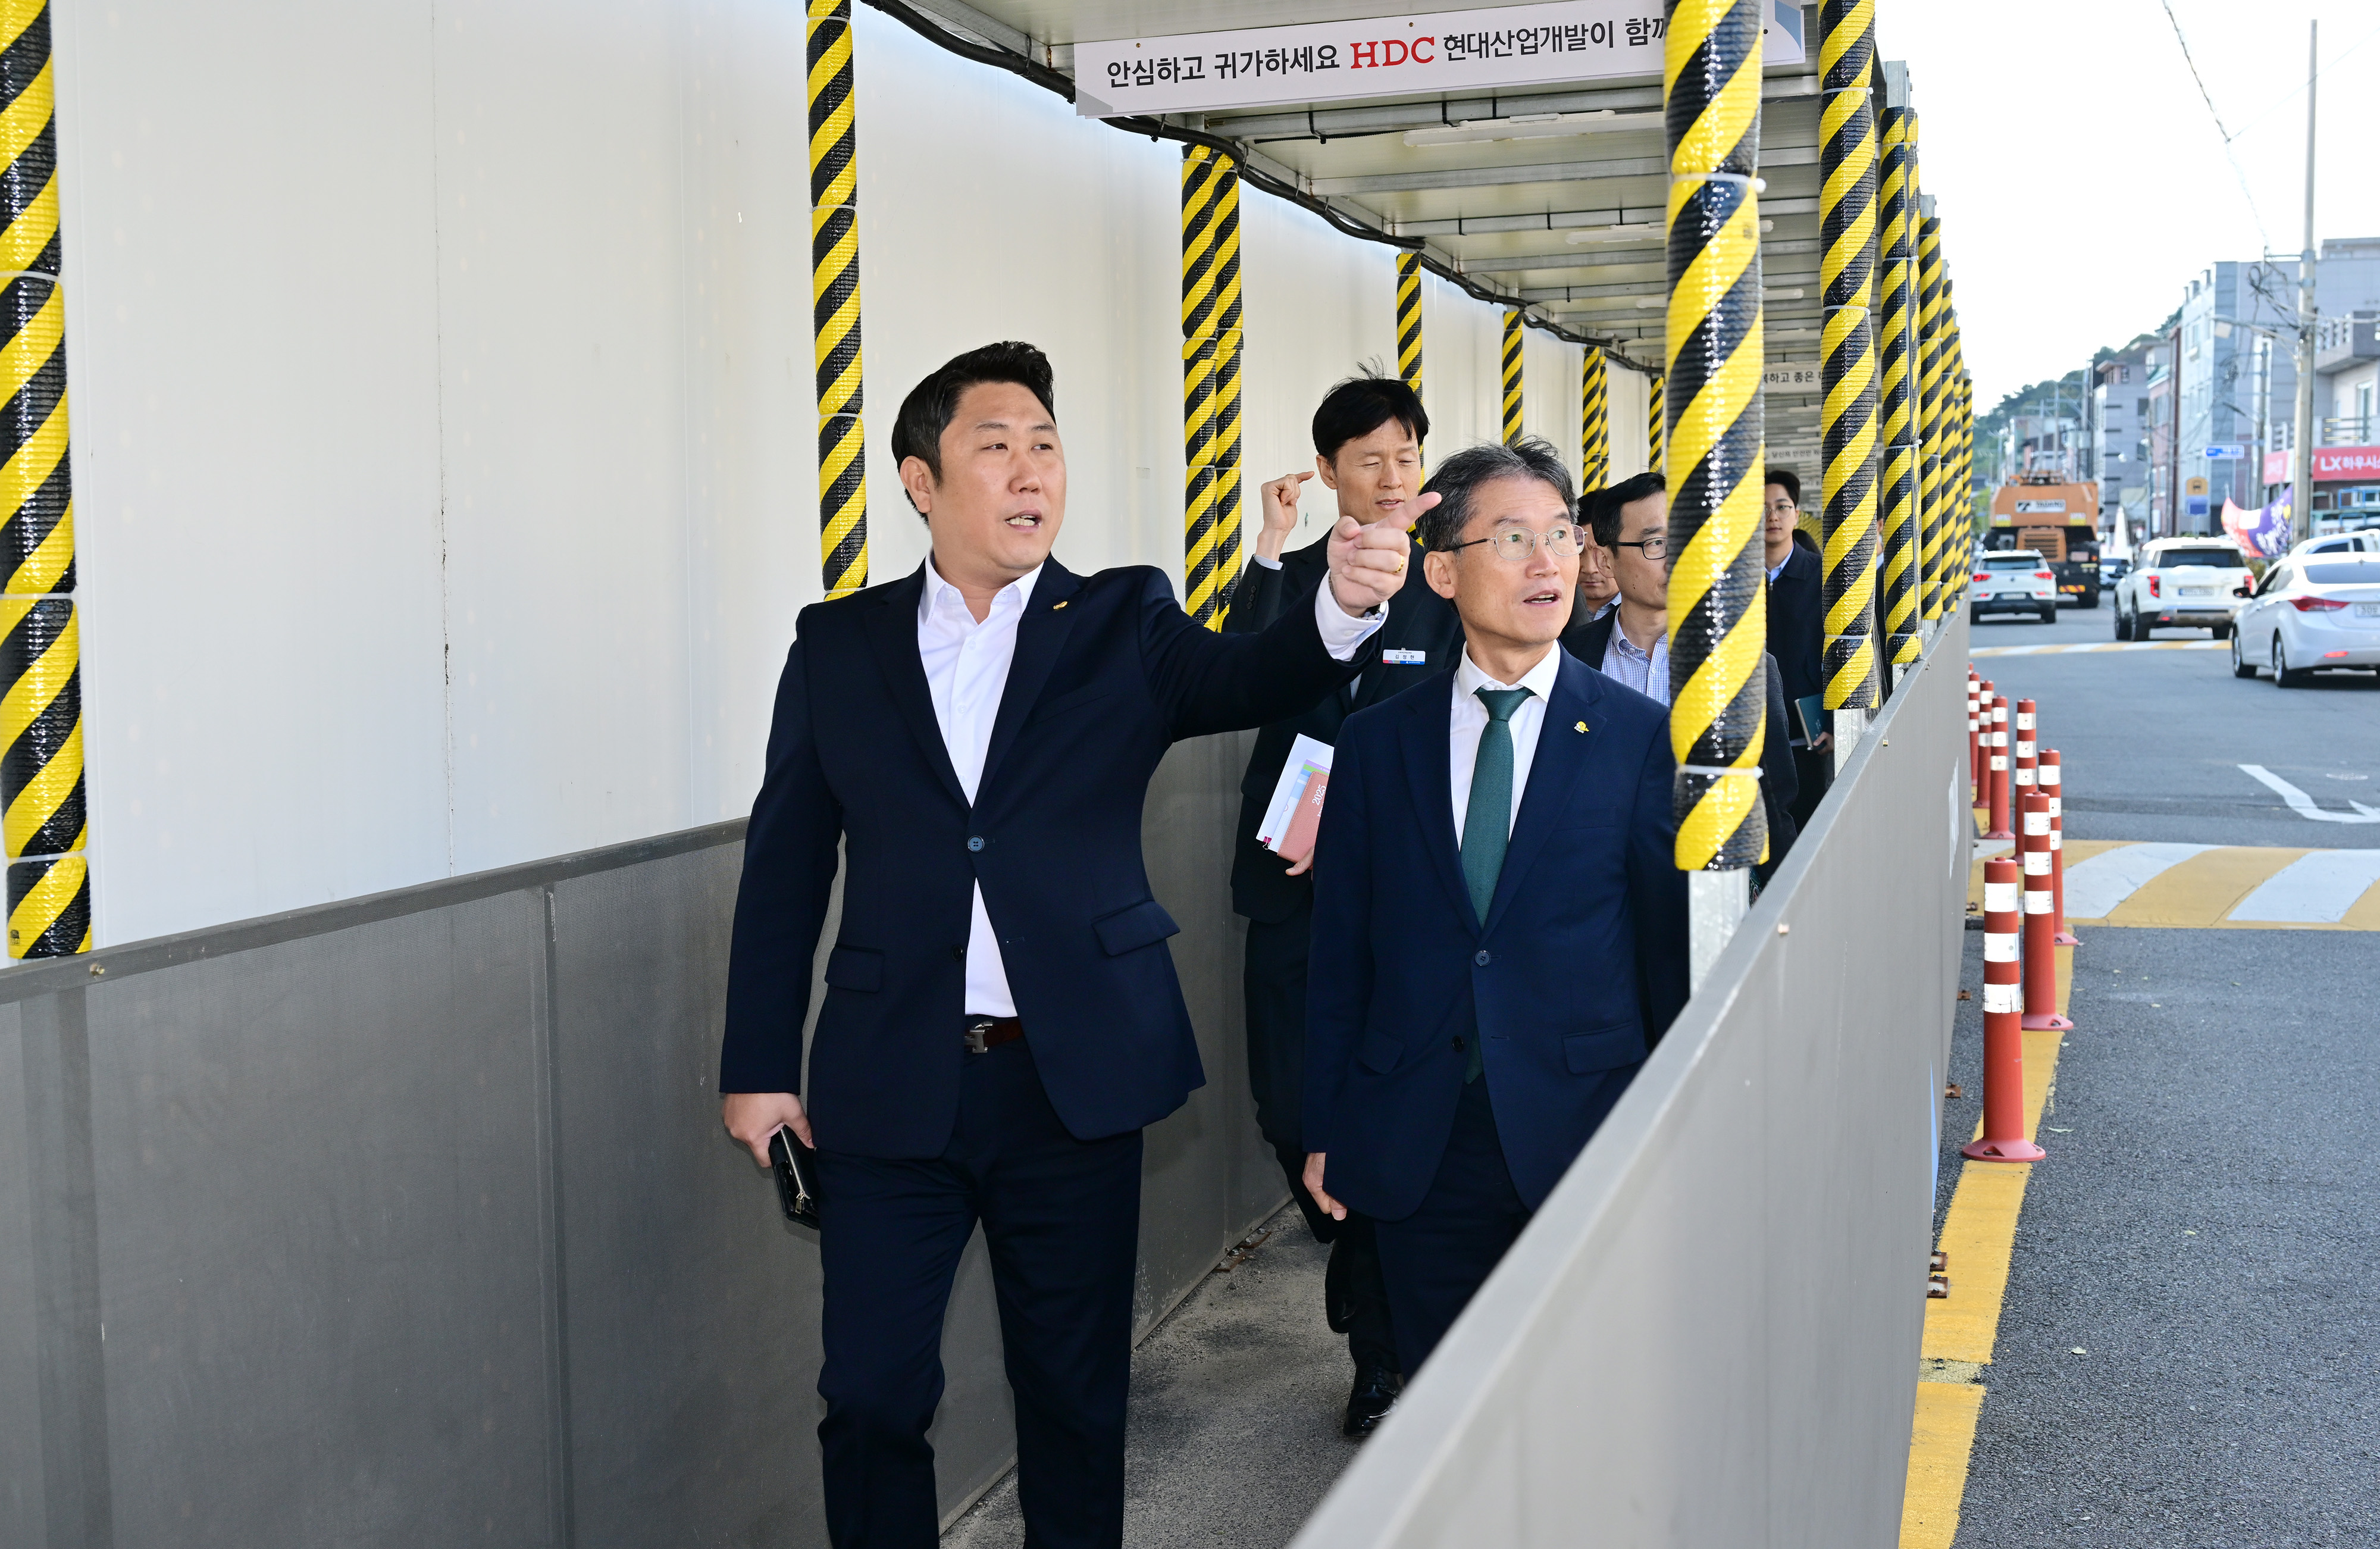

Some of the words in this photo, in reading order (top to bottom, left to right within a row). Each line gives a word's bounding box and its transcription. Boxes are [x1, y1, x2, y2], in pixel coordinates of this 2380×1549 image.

[1107, 57, 1205, 88] 안심하고
[1214, 45, 1340, 79] 귀가하세요
[1349, 36, 1435, 69] HDC
[1443, 21, 1614, 61] 현대산업개발이
[1794, 371, 1815, 383] 좋은
[1312, 784, 1327, 806] 2025
